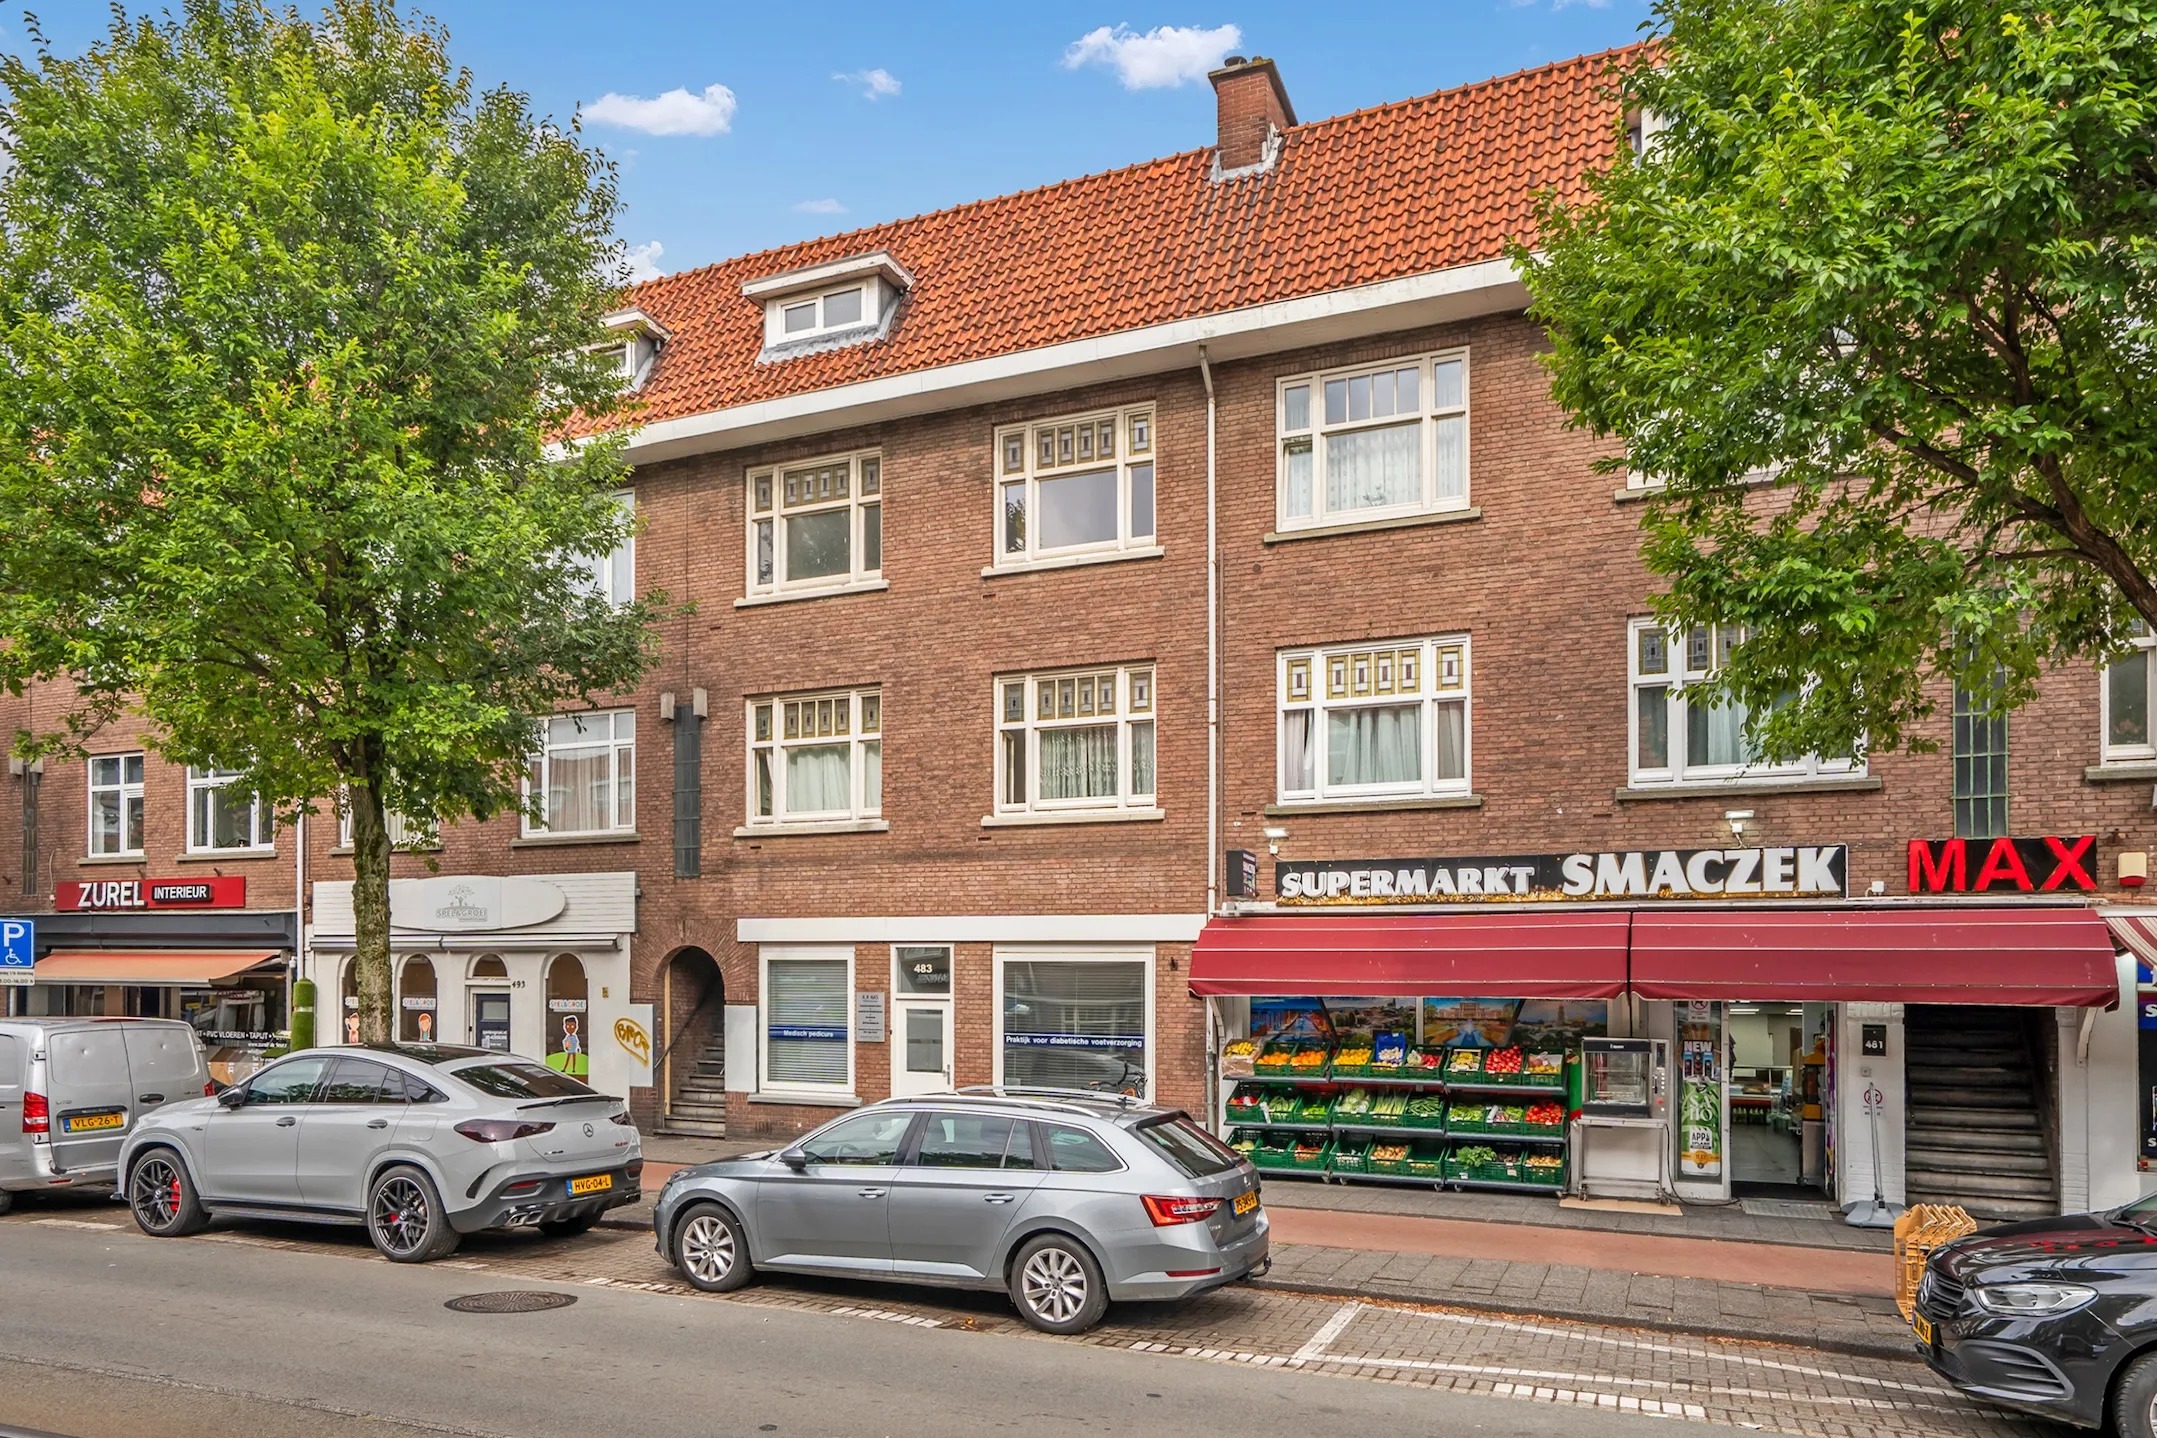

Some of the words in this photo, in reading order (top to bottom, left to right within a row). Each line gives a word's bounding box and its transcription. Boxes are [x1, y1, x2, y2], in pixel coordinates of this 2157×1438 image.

[1908, 836, 2097, 892] MAX
[1281, 867, 1535, 897] SUPERMARKT
[1562, 847, 1841, 896] SMACZEK
[78, 881, 145, 908] ZUREL
[153, 885, 207, 900] INTERIEUR
[3, 923, 25, 947] P
[913, 963, 933, 973] 483
[512, 980, 526, 988] 493
[206, 1030, 218, 1039] PVC
[218, 1030, 246, 1040] VLOEREN
[249, 1032, 268, 1040] TAPIJT
[809, 1030, 834, 1038] pedicure
[1006, 1036, 1031, 1044] Praktijk
[1050, 1037, 1089, 1045] diabetische
[1091, 1039, 1143, 1048] voetverzorging
[1683, 1041, 1713, 1053] NEW
[1865, 1040, 1883, 1049] 481
[74, 1115, 119, 1128] VLG-26-T
[574, 1177, 610, 1191] HVG-04-L
